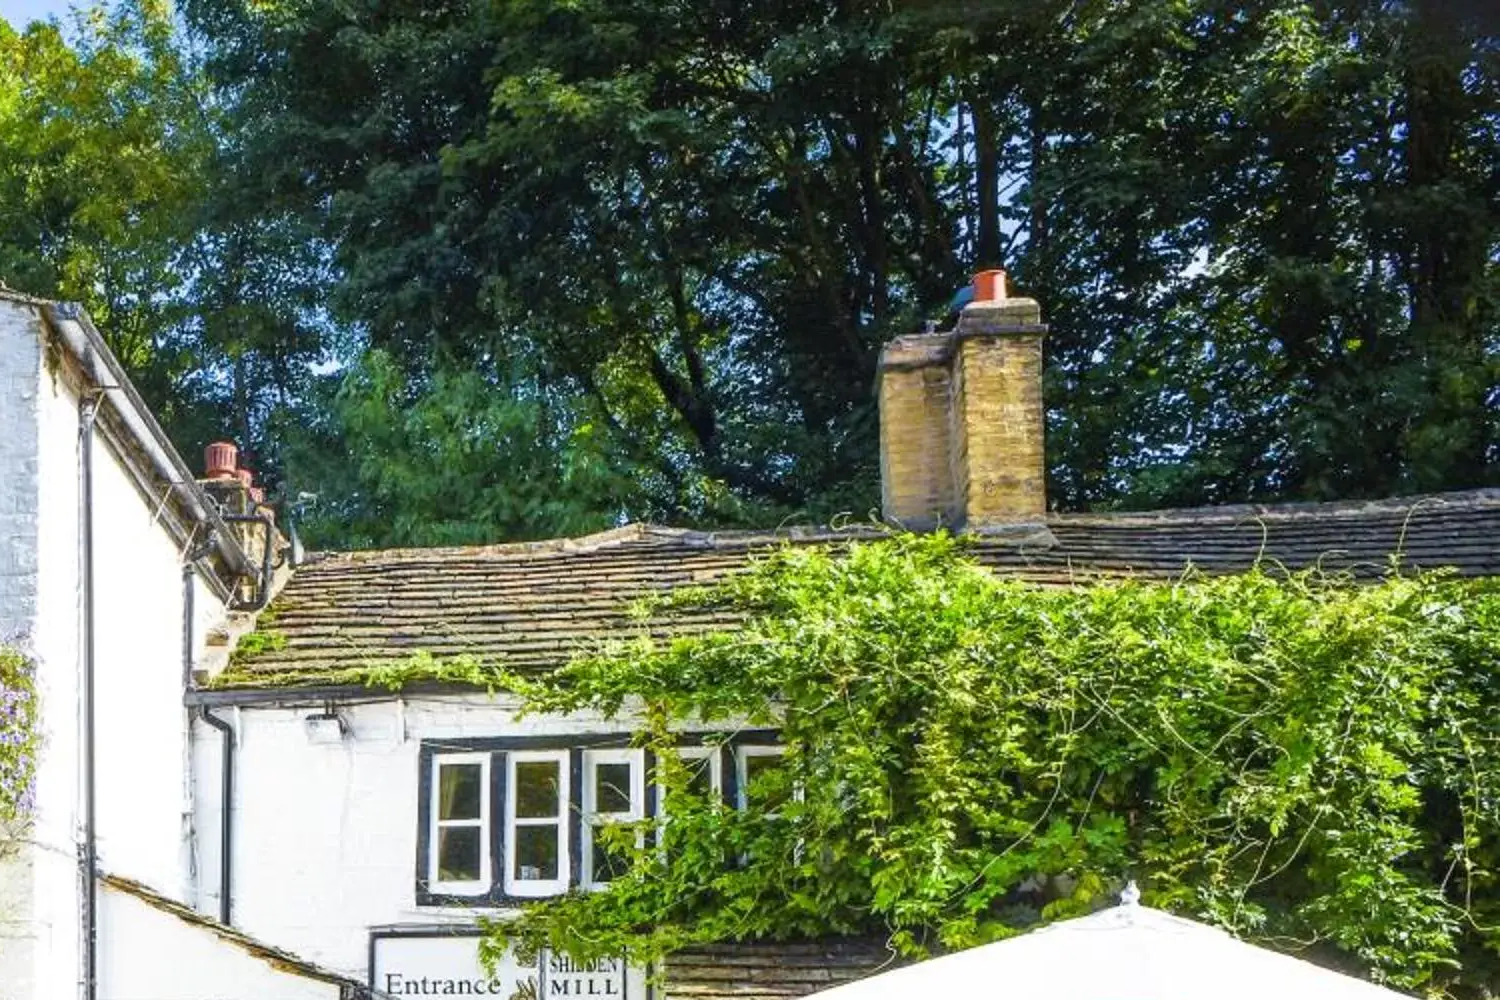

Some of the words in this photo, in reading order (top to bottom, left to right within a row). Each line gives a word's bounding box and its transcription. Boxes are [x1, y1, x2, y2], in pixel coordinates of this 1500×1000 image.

[550, 956, 617, 973] SHIDEN
[384, 973, 501, 995] Entrance
[551, 979, 619, 995] MILL
